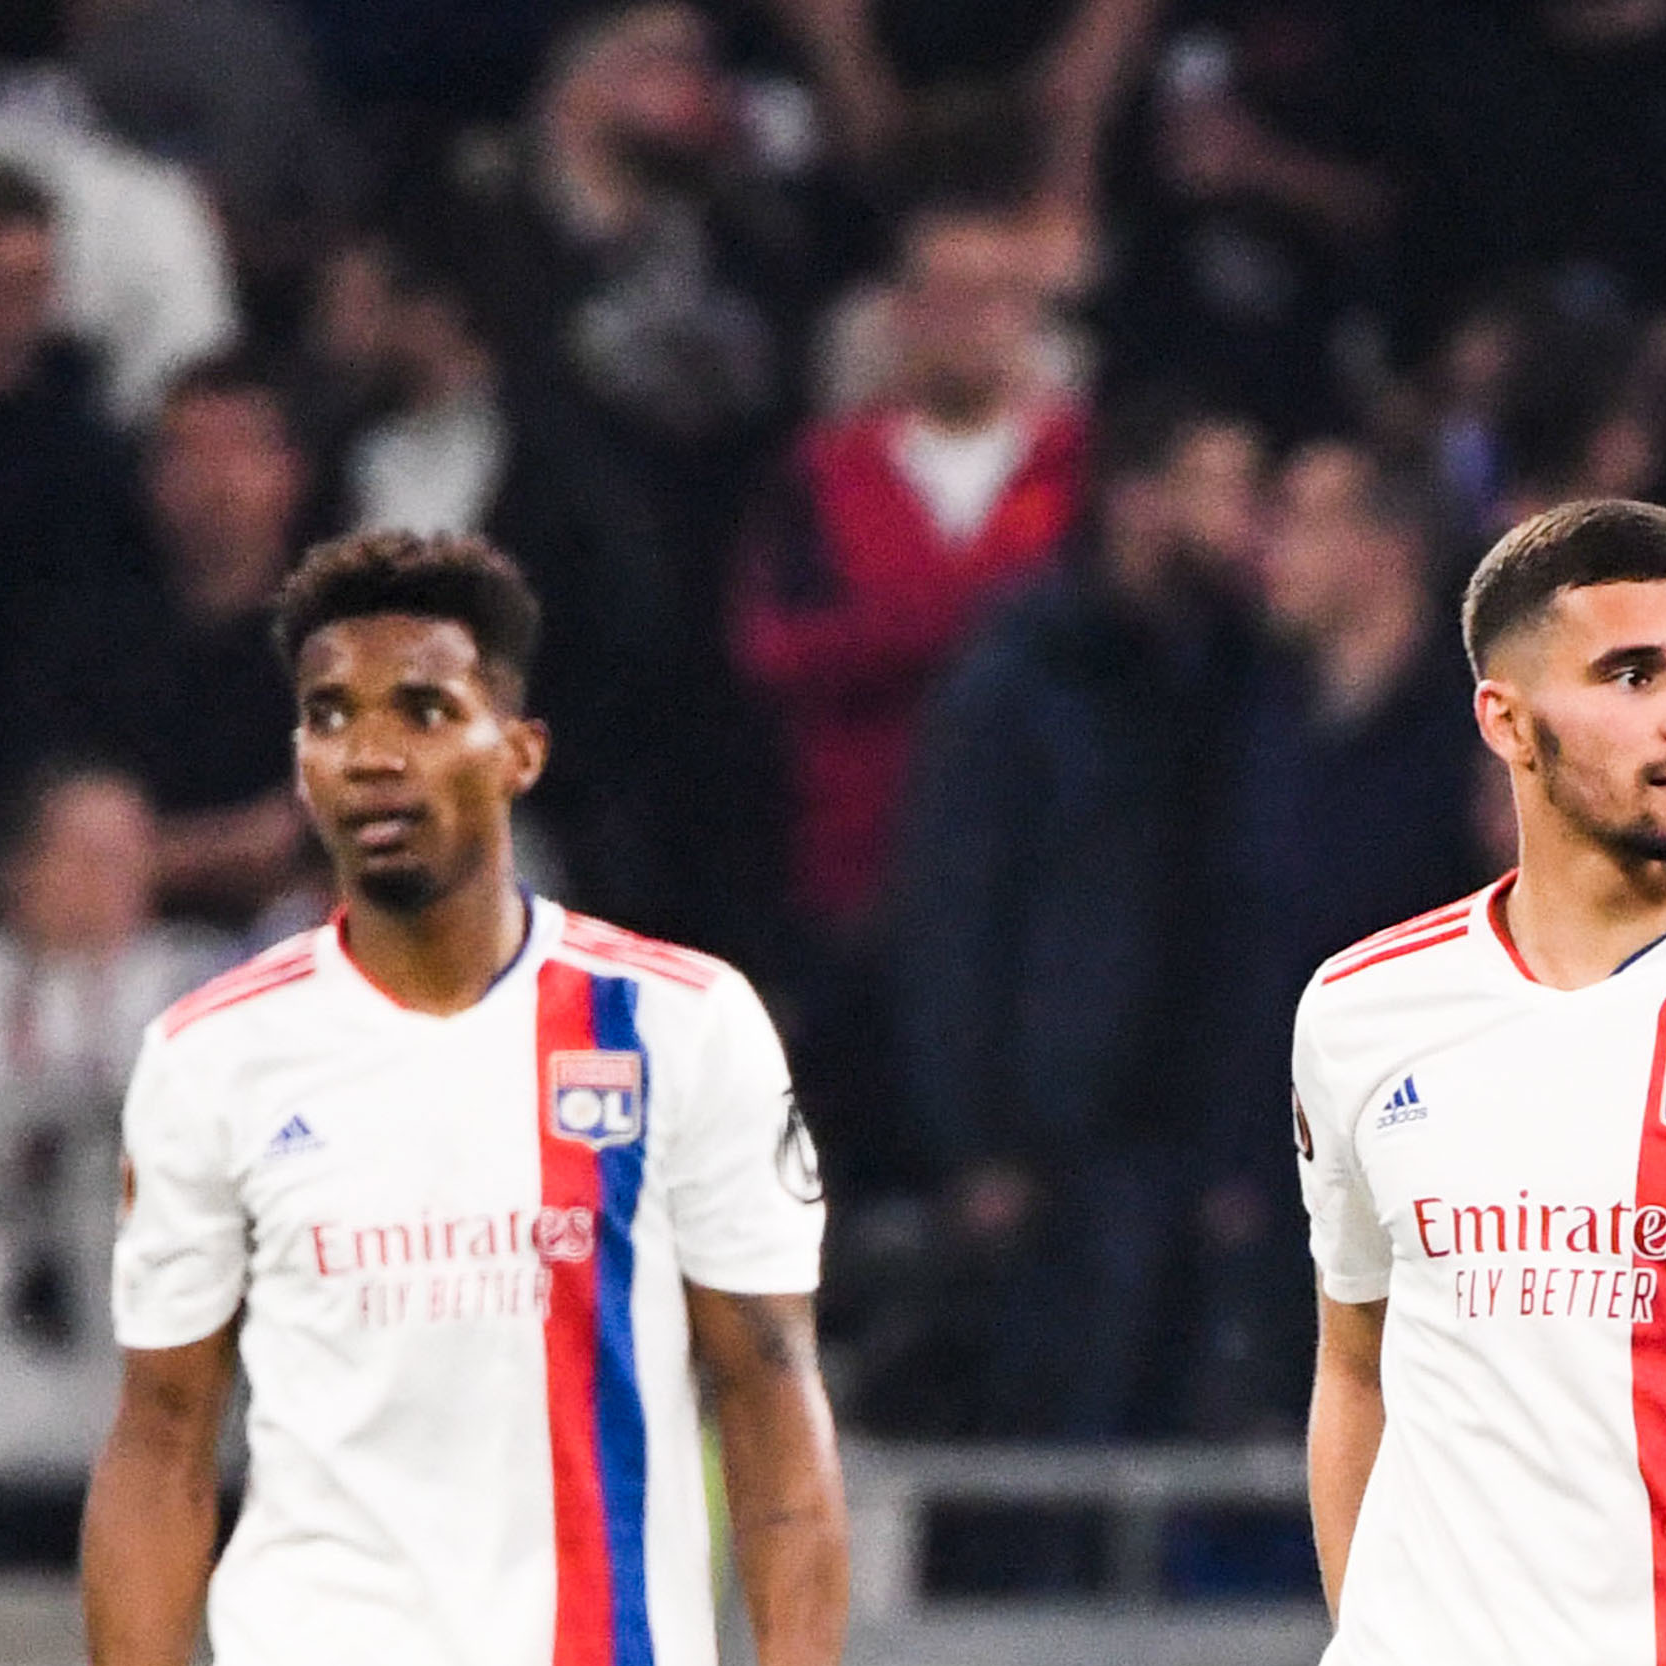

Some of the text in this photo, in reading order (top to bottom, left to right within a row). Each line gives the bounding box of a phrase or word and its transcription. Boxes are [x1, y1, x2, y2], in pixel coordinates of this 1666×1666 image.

[559, 1089, 633, 1132] OL
[312, 1206, 596, 1277] Emirates
[1456, 1267, 1658, 1323] FLY BETTER
